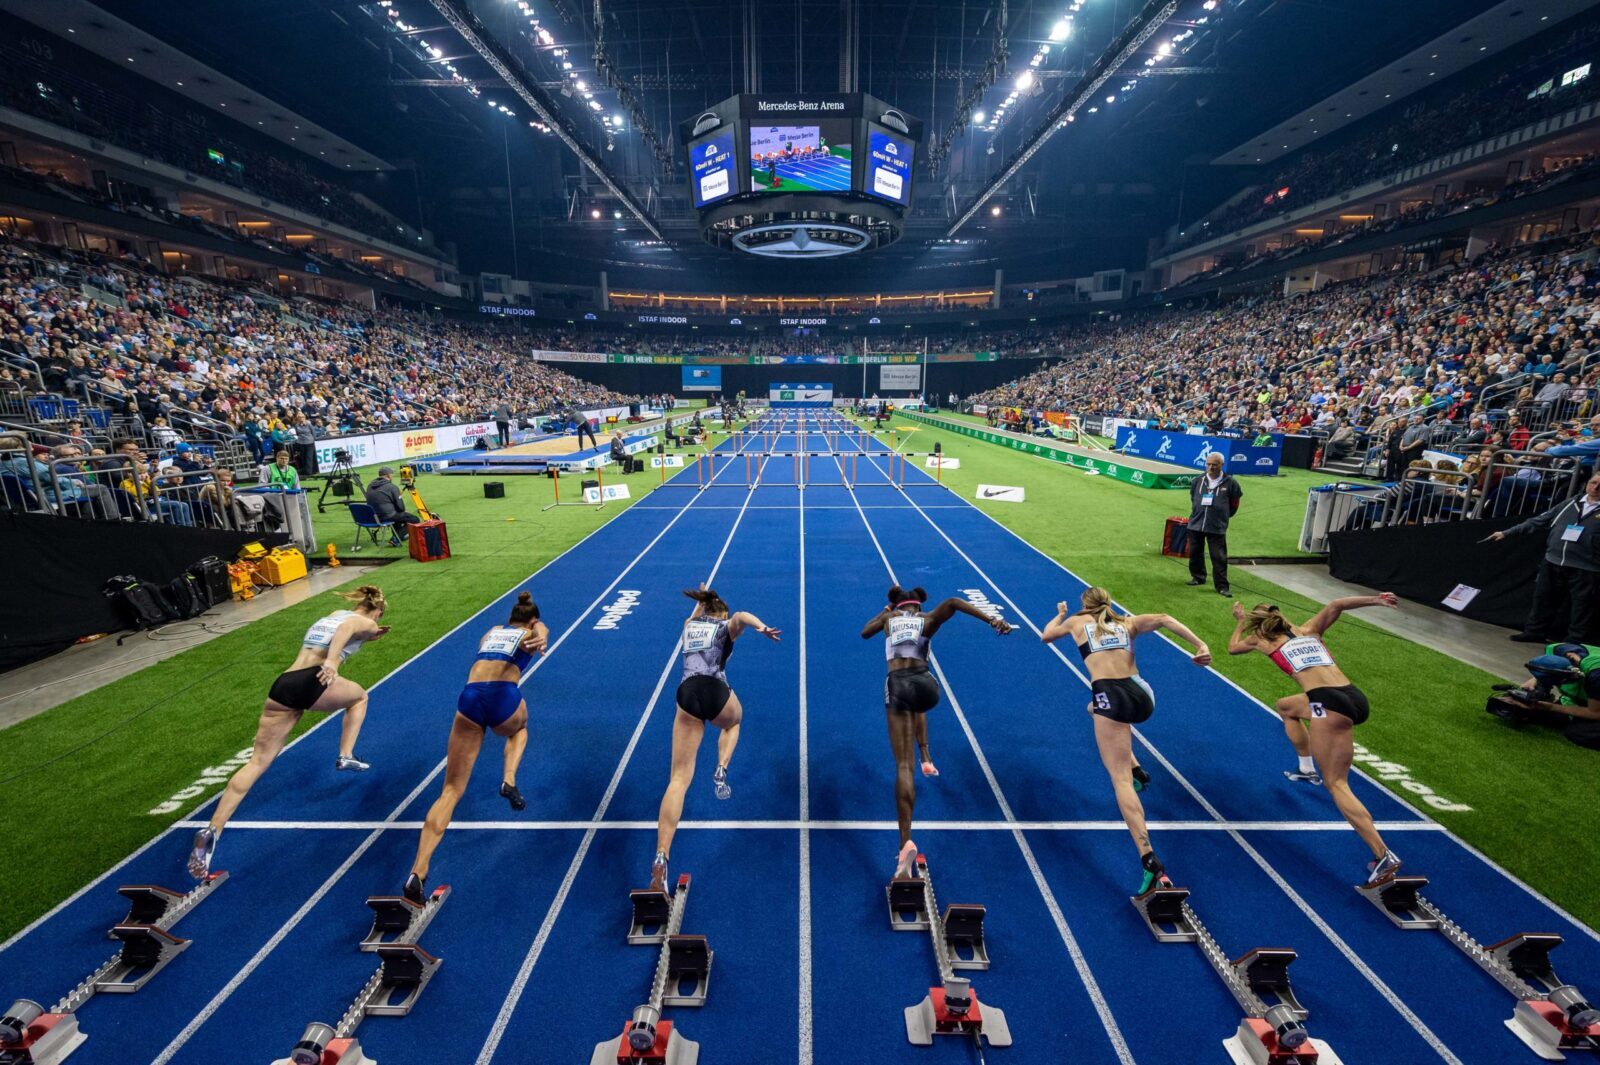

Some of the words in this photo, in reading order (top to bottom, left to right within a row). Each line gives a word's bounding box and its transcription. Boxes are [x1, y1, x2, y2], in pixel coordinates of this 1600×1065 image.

[758, 100, 819, 111] Mercedes-Benz
[820, 100, 845, 110] Arena
[478, 305, 502, 314] ISTAF
[503, 307, 536, 317] INDOOR
[638, 315, 658, 323] ISTAF
[659, 316, 687, 324] INDOOR
[413, 435, 433, 447] LOTTO
[1131, 470, 1144, 481] AOK
[892, 622, 919, 632] AMUSAN
[1098, 694, 1108, 709] 5
[1313, 704, 1322, 717] 6
[148, 746, 254, 815] olytan
